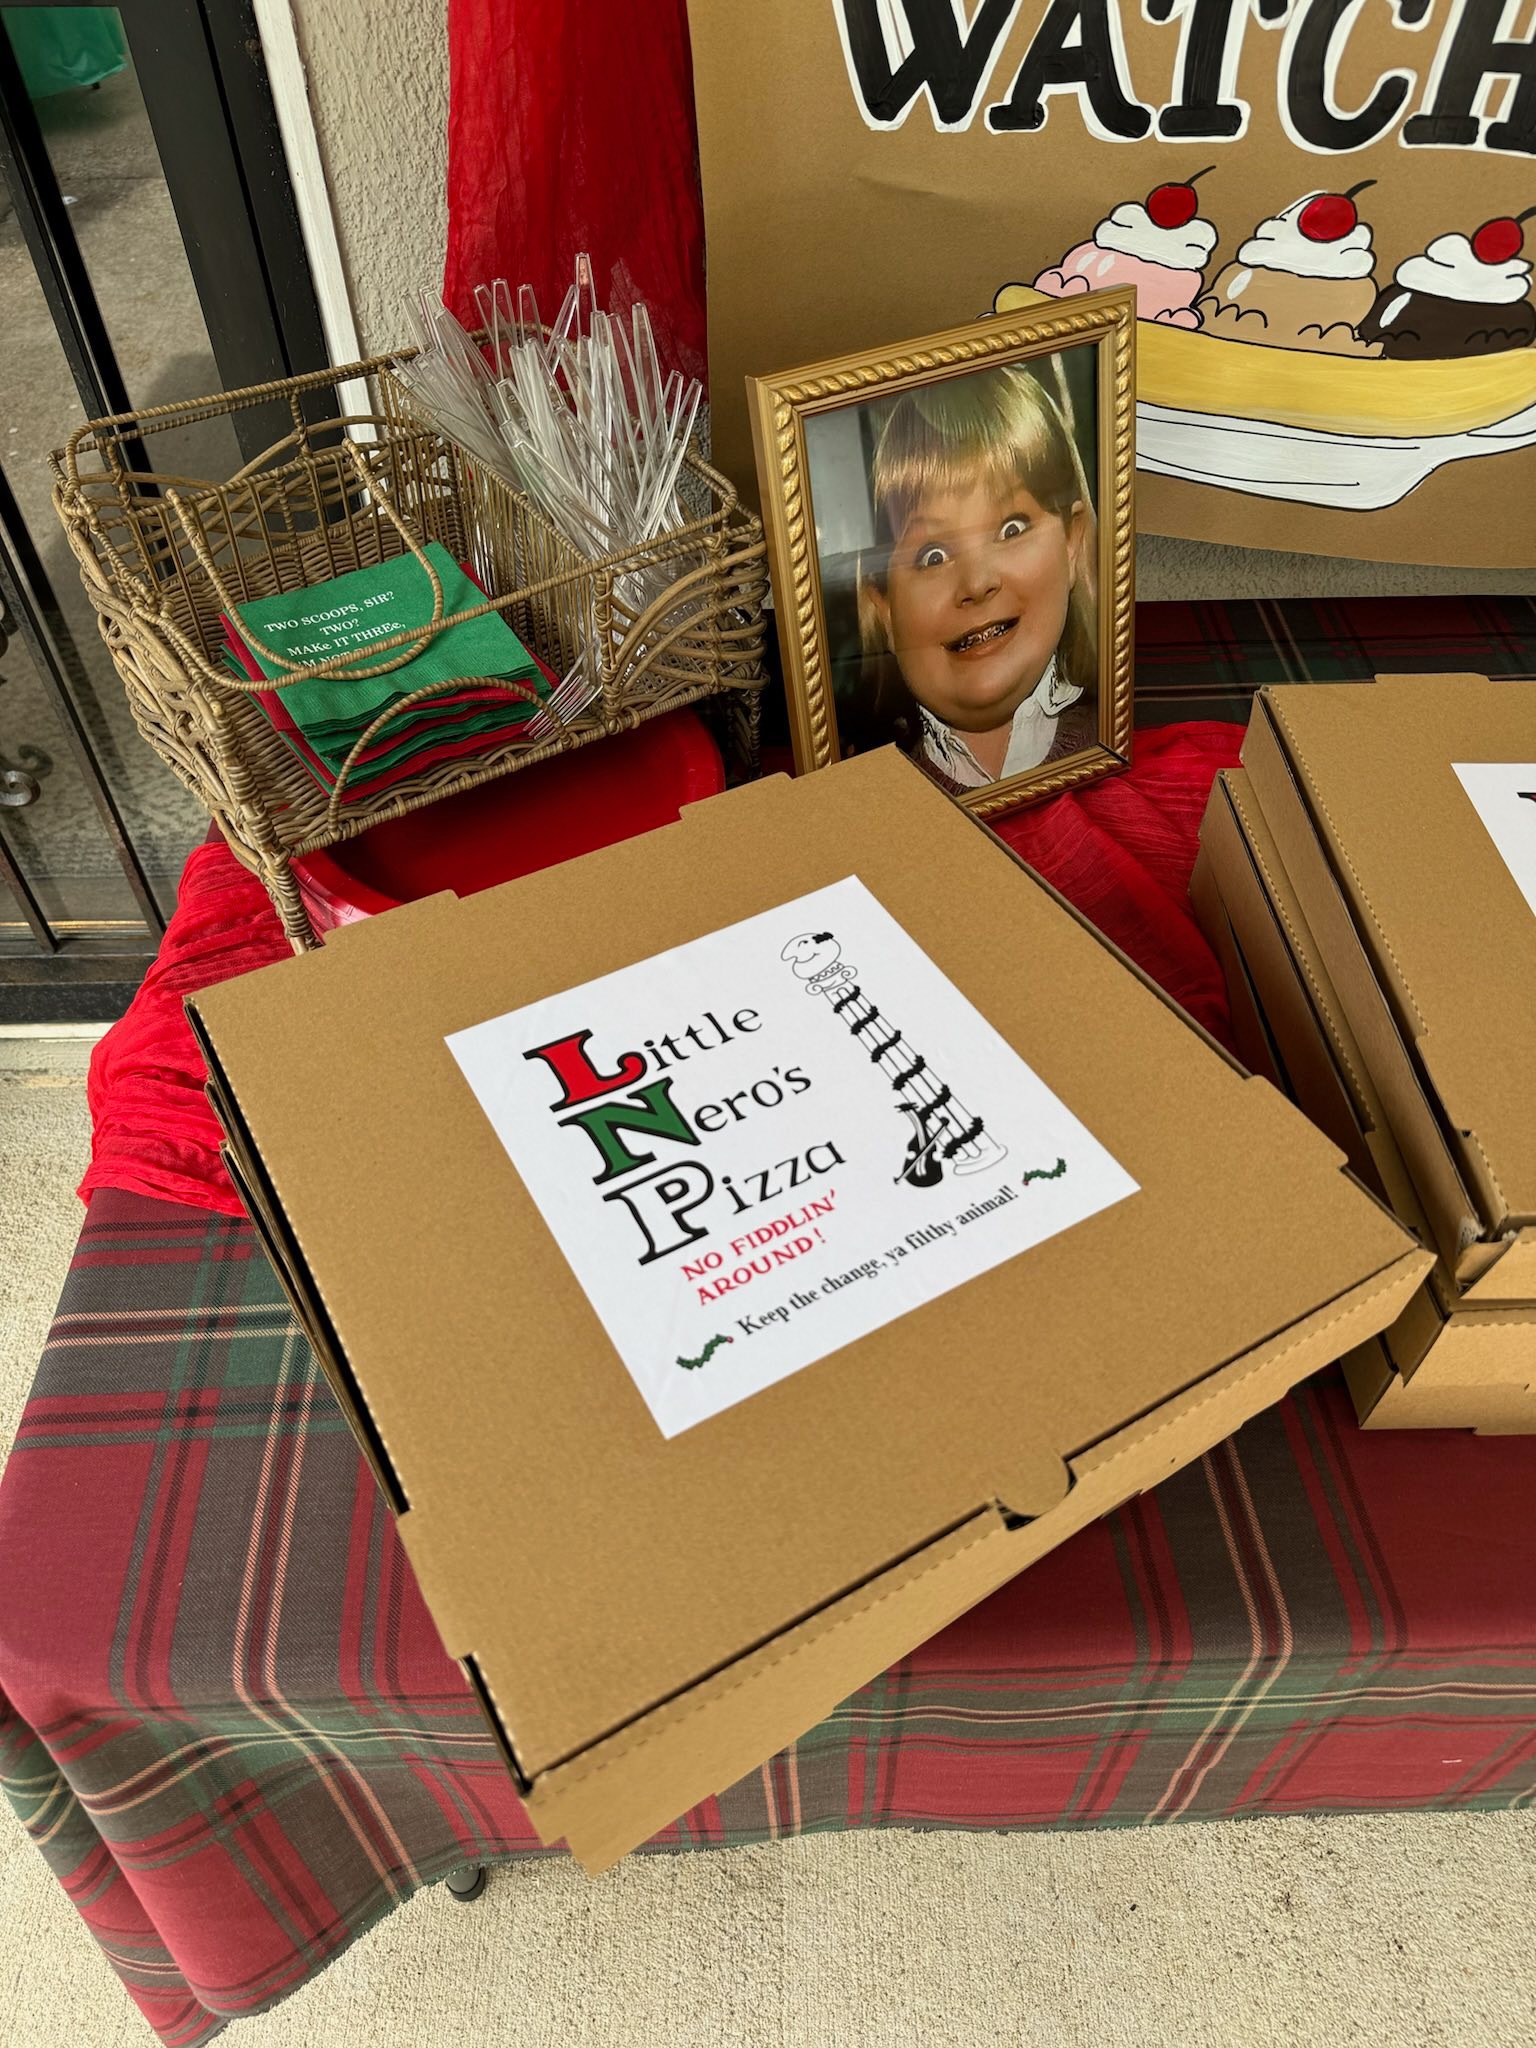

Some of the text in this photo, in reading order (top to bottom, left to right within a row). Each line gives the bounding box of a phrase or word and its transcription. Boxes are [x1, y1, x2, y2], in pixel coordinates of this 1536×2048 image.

[835, 0, 1536, 156] WATCH
[264, 591, 394, 633] TWO SCOOPS, SIR?
[319, 618, 360, 636] TWO?
[333, 635, 349, 648] IT
[522, 1007, 763, 1112] Little
[557, 1064, 812, 1186] Nero's
[602, 1140, 847, 1267] Pizza
[681, 1189, 836, 1282] NO FIDDLIN'
[735, 1184, 1020, 1336] Keep the change, ya filthy animal!
